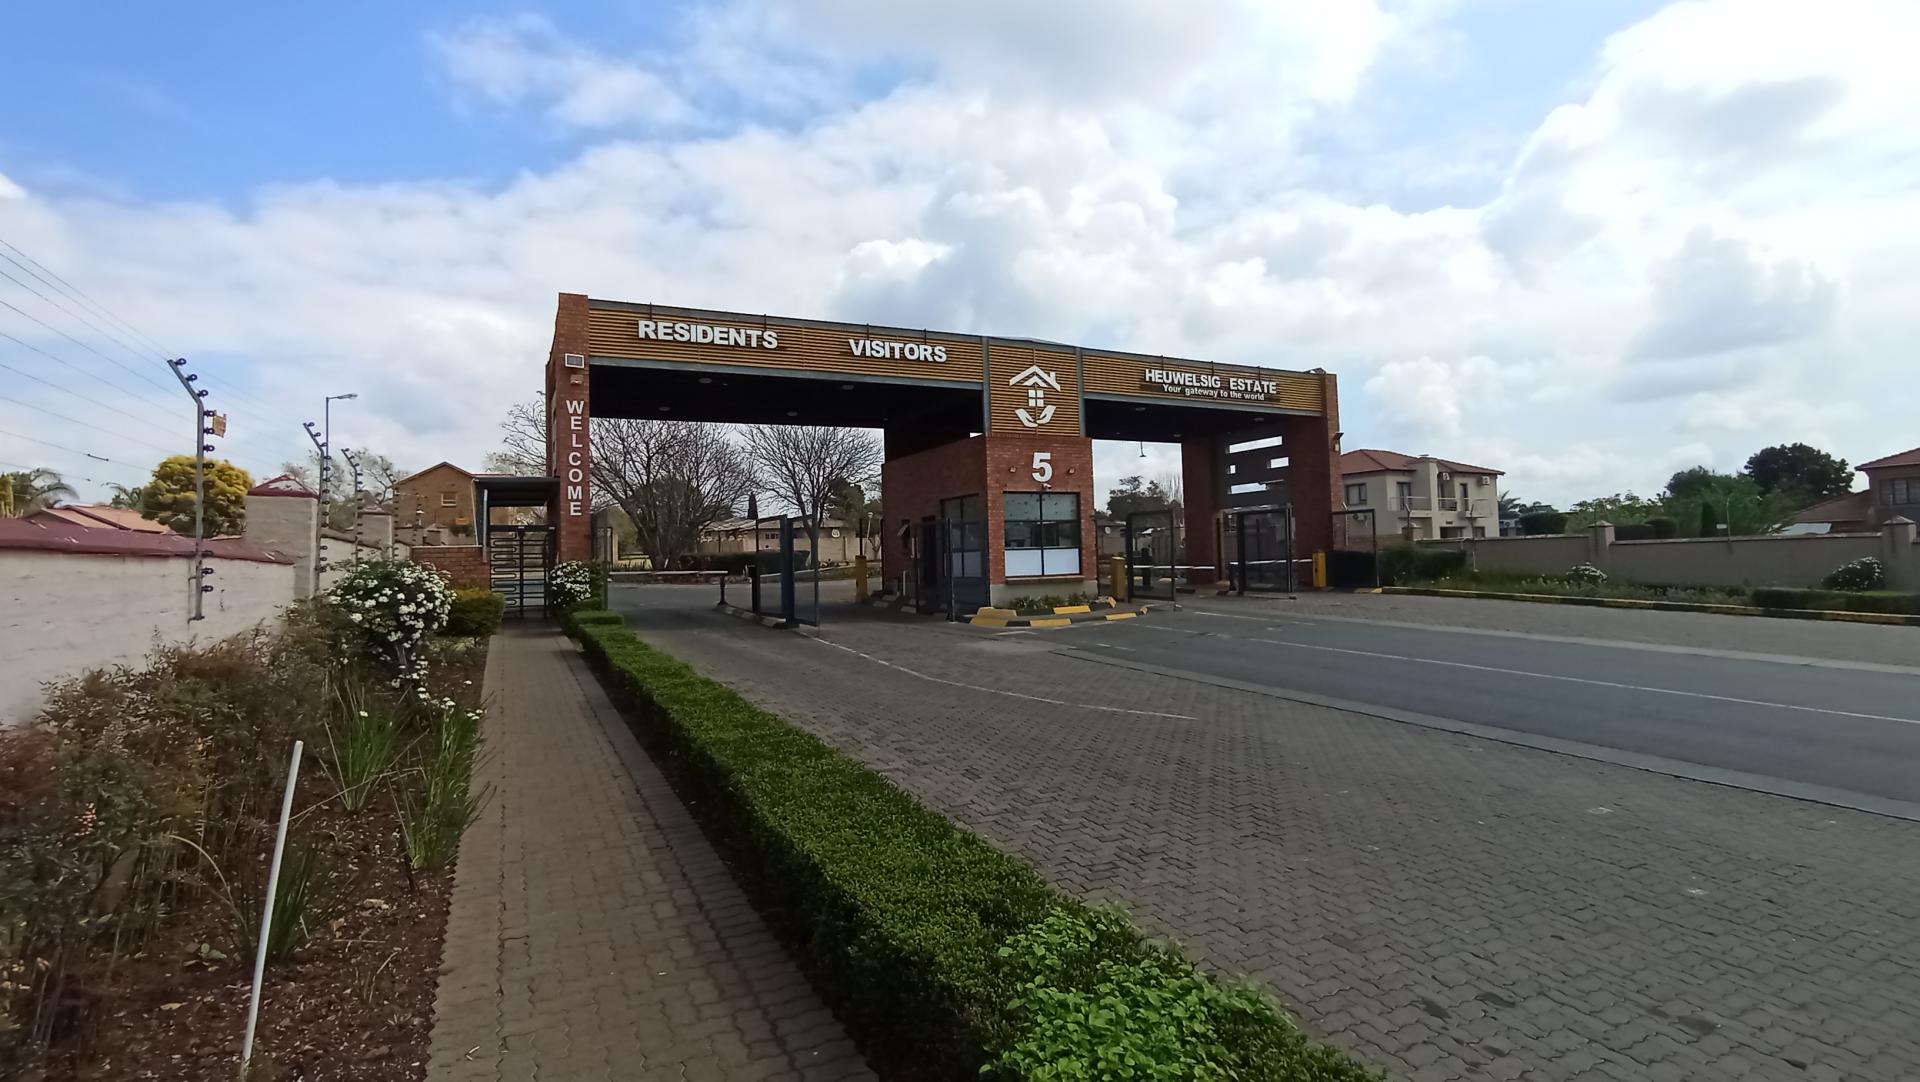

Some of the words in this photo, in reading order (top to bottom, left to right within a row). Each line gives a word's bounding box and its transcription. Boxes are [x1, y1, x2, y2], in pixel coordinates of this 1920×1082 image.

[638, 319, 778, 349] RESIDENTS
[848, 339, 947, 363] VISITORS
[1145, 369, 1221, 388] HEUWELSIG
[1229, 378, 1277, 394] ESTATE
[1162, 383, 1182, 393] Your
[1185, 387, 1219, 398] gateway
[1220, 389, 1228, 398] to
[1230, 390, 1242, 399] the
[1243, 392, 1265, 401] world
[566, 399, 584, 516] WELCOME
[1031, 452, 1053, 483] 5
